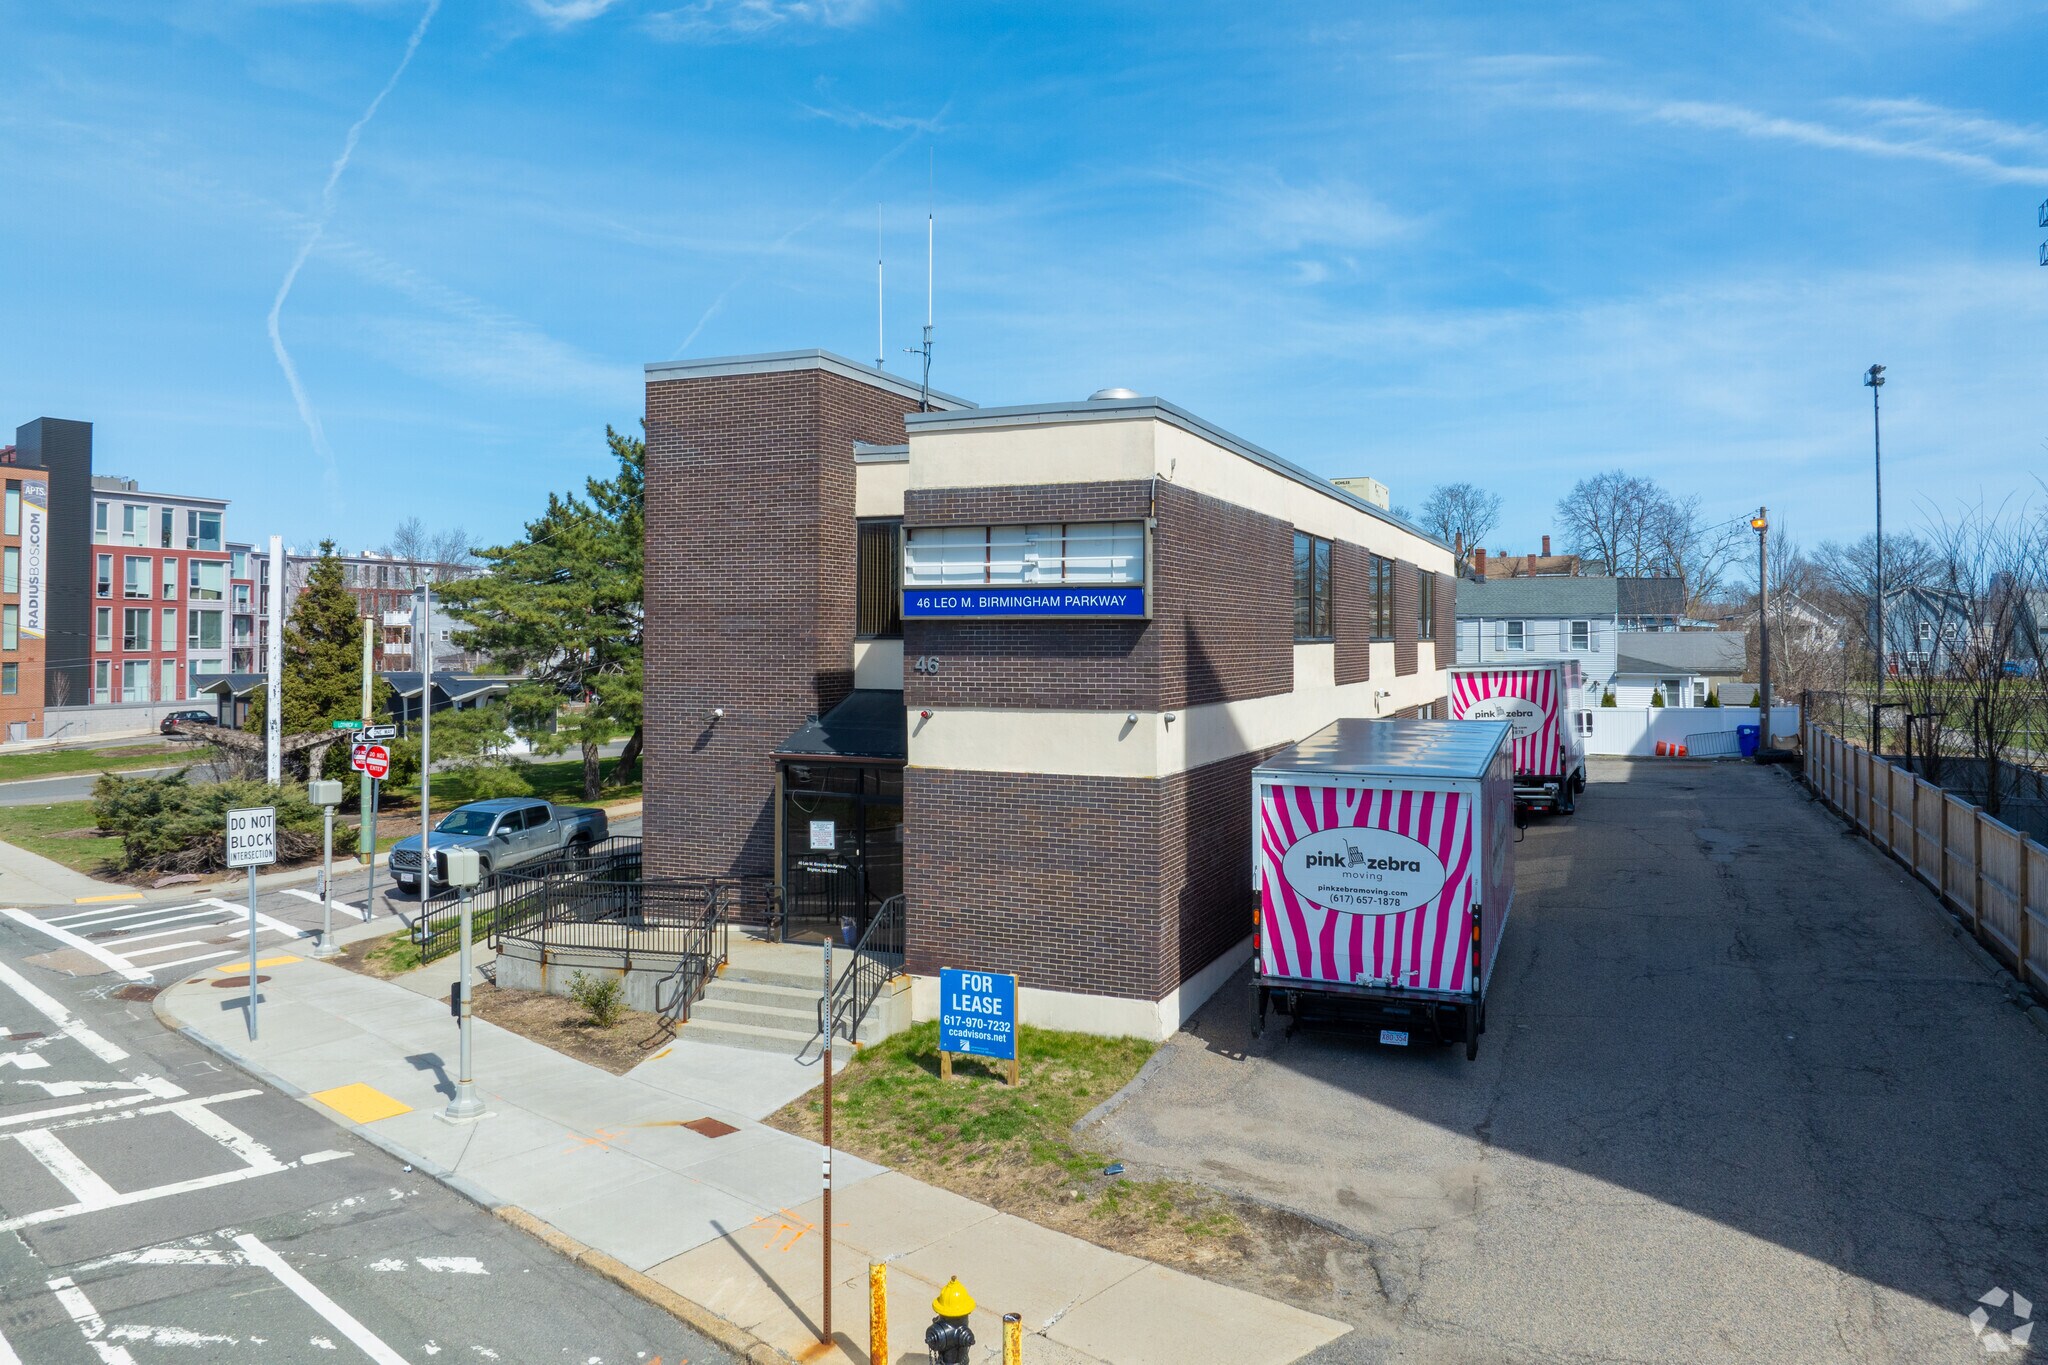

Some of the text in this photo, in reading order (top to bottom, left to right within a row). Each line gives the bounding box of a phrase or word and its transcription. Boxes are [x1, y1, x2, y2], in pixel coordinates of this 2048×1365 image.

[29, 512, 41, 629] RADIUSBOS.COM
[916, 595, 1127, 609] 46 LEO M. BIRMINGHAM PARKWAY
[914, 655, 940, 674] 46
[1475, 709, 1533, 720] pink zebra
[231, 815, 273, 831] DO NOT
[231, 833, 273, 849] BLOCK
[230, 850, 273, 862] INTERSECTION
[1305, 850, 1421, 873] pink zebra
[1342, 871, 1383, 882] moving
[1317, 884, 1408, 897] pinkzebramoving.com
[1329, 893, 1401, 907] (617) 657-1878
[961, 973, 993, 993] FOR
[952, 993, 1002, 1016] LEASE
[943, 1014, 1011, 1033] 617-970-7232
[948, 1028, 1007, 1043] ccadvisors.net
